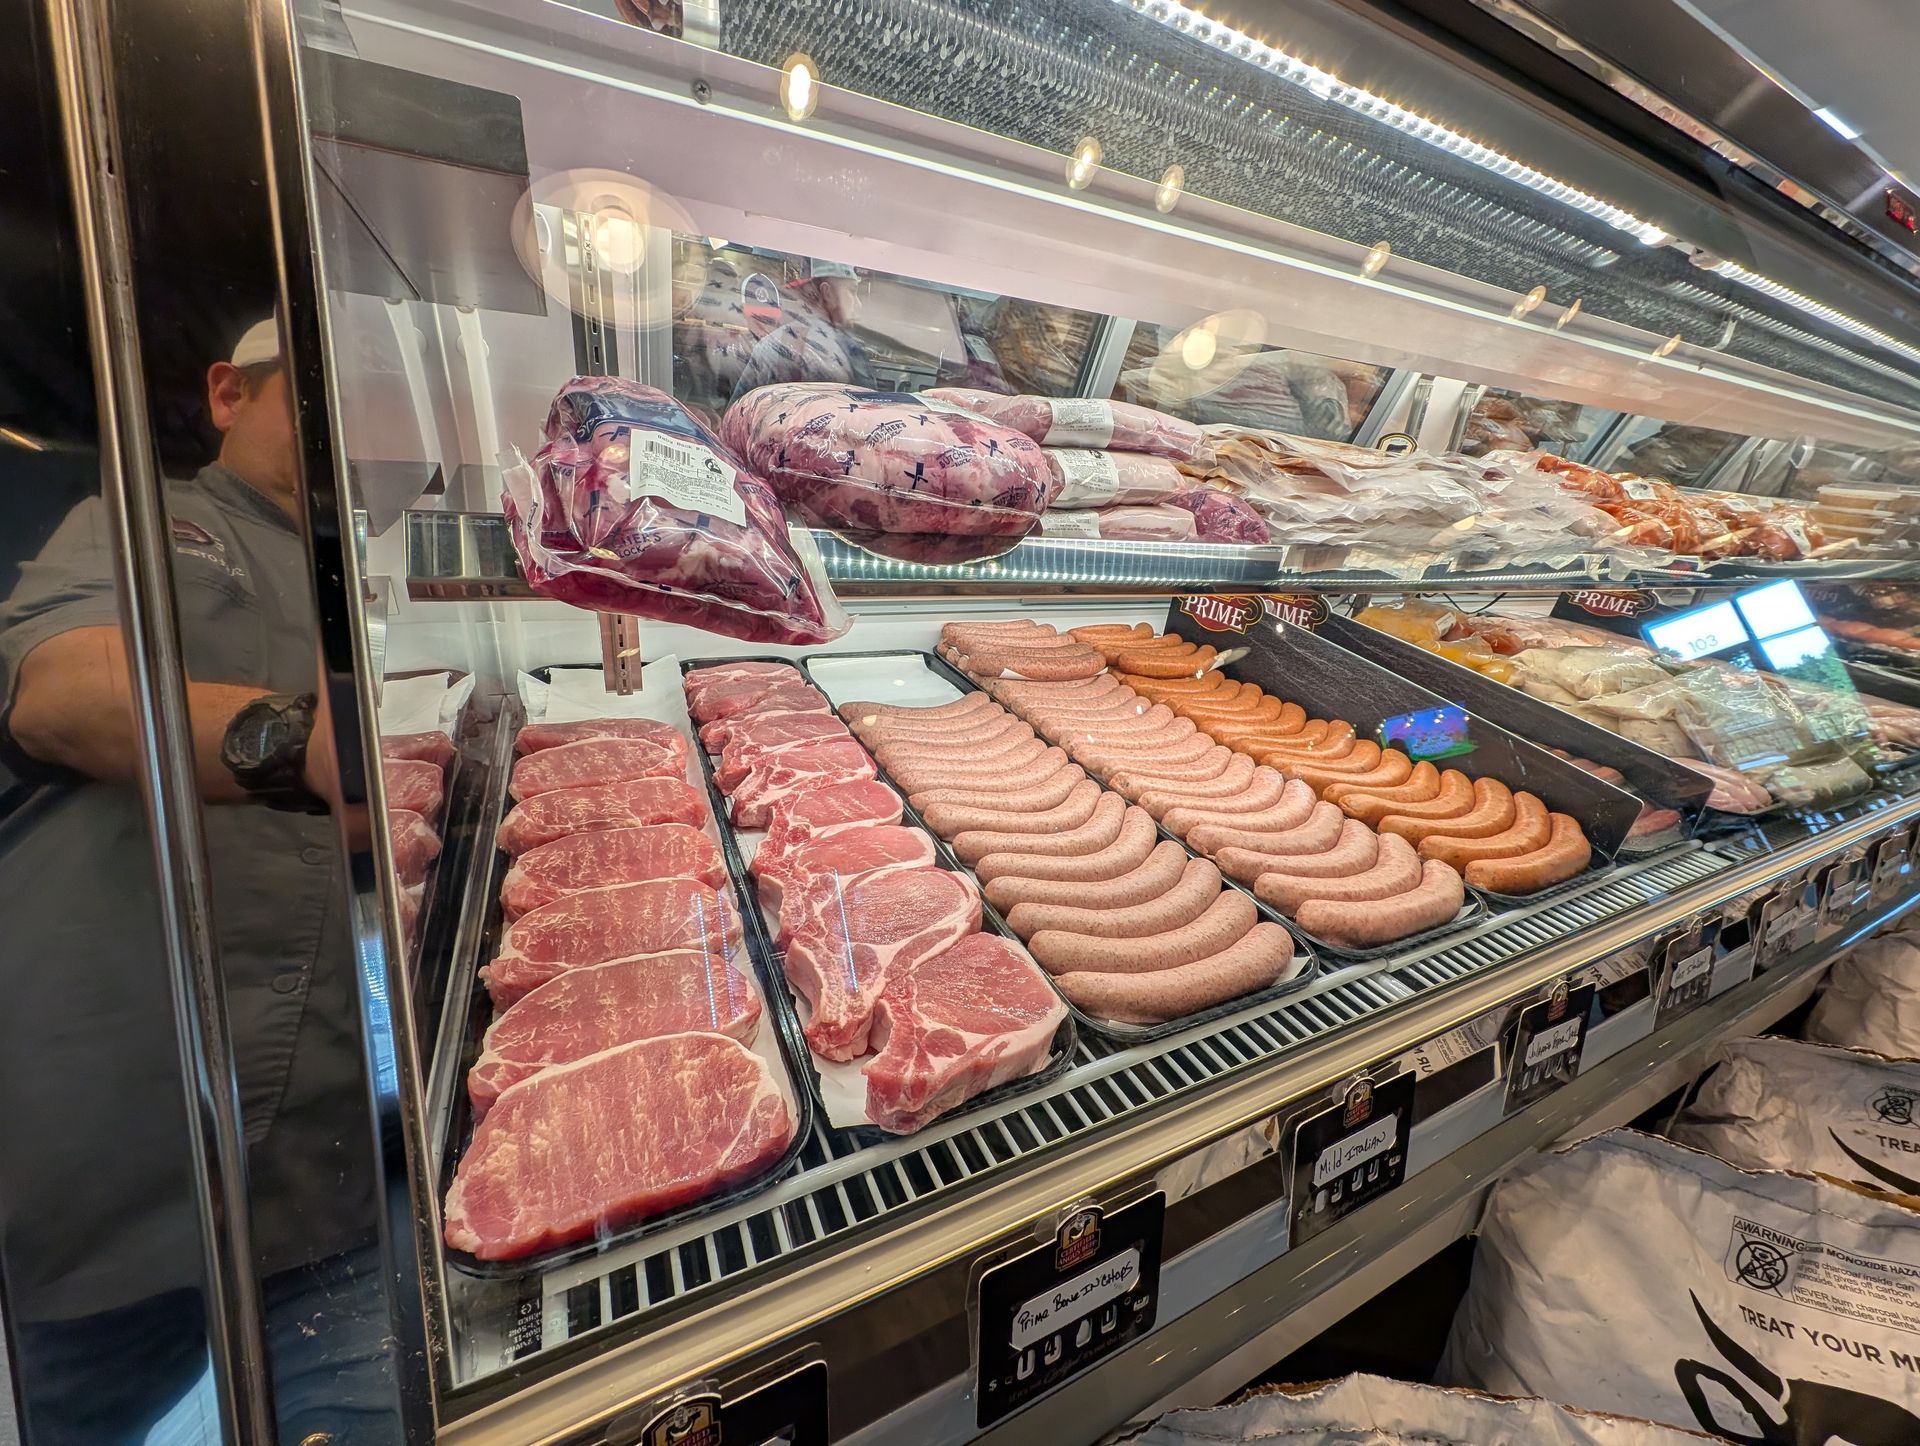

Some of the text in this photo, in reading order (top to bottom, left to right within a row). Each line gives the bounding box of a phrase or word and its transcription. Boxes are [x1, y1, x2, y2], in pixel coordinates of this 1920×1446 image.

[1184, 595, 1247, 629] PRIME
[1574, 590, 1639, 615] PRIME
[1688, 634, 1719, 653] 103
[1319, 1150, 1342, 1180] Mild
[1743, 1222, 1804, 1252] WARNING
[1826, 1248, 1888, 1272] MONOXIDE
[1821, 1262, 1861, 1278] charcoal
[1863, 1274, 1893, 1287] inside
[1895, 1283, 1915, 1292] can
[1833, 1273, 1859, 1286] gives
[1860, 1280, 1873, 1289] off
[1793, 1285, 1829, 1301] NEVER
[1855, 1302, 1901, 1319] charcoal
[1837, 1283, 1866, 1296] which
[1867, 1289, 1888, 1301] has
[1889, 1296, 1903, 1305] no
[1832, 1304, 1875, 1321] vehicles
[1876, 1315, 1887, 1323] or
[1738, 1304, 1796, 1340] TREAT
[1802, 1326, 1885, 1365] YOUR
